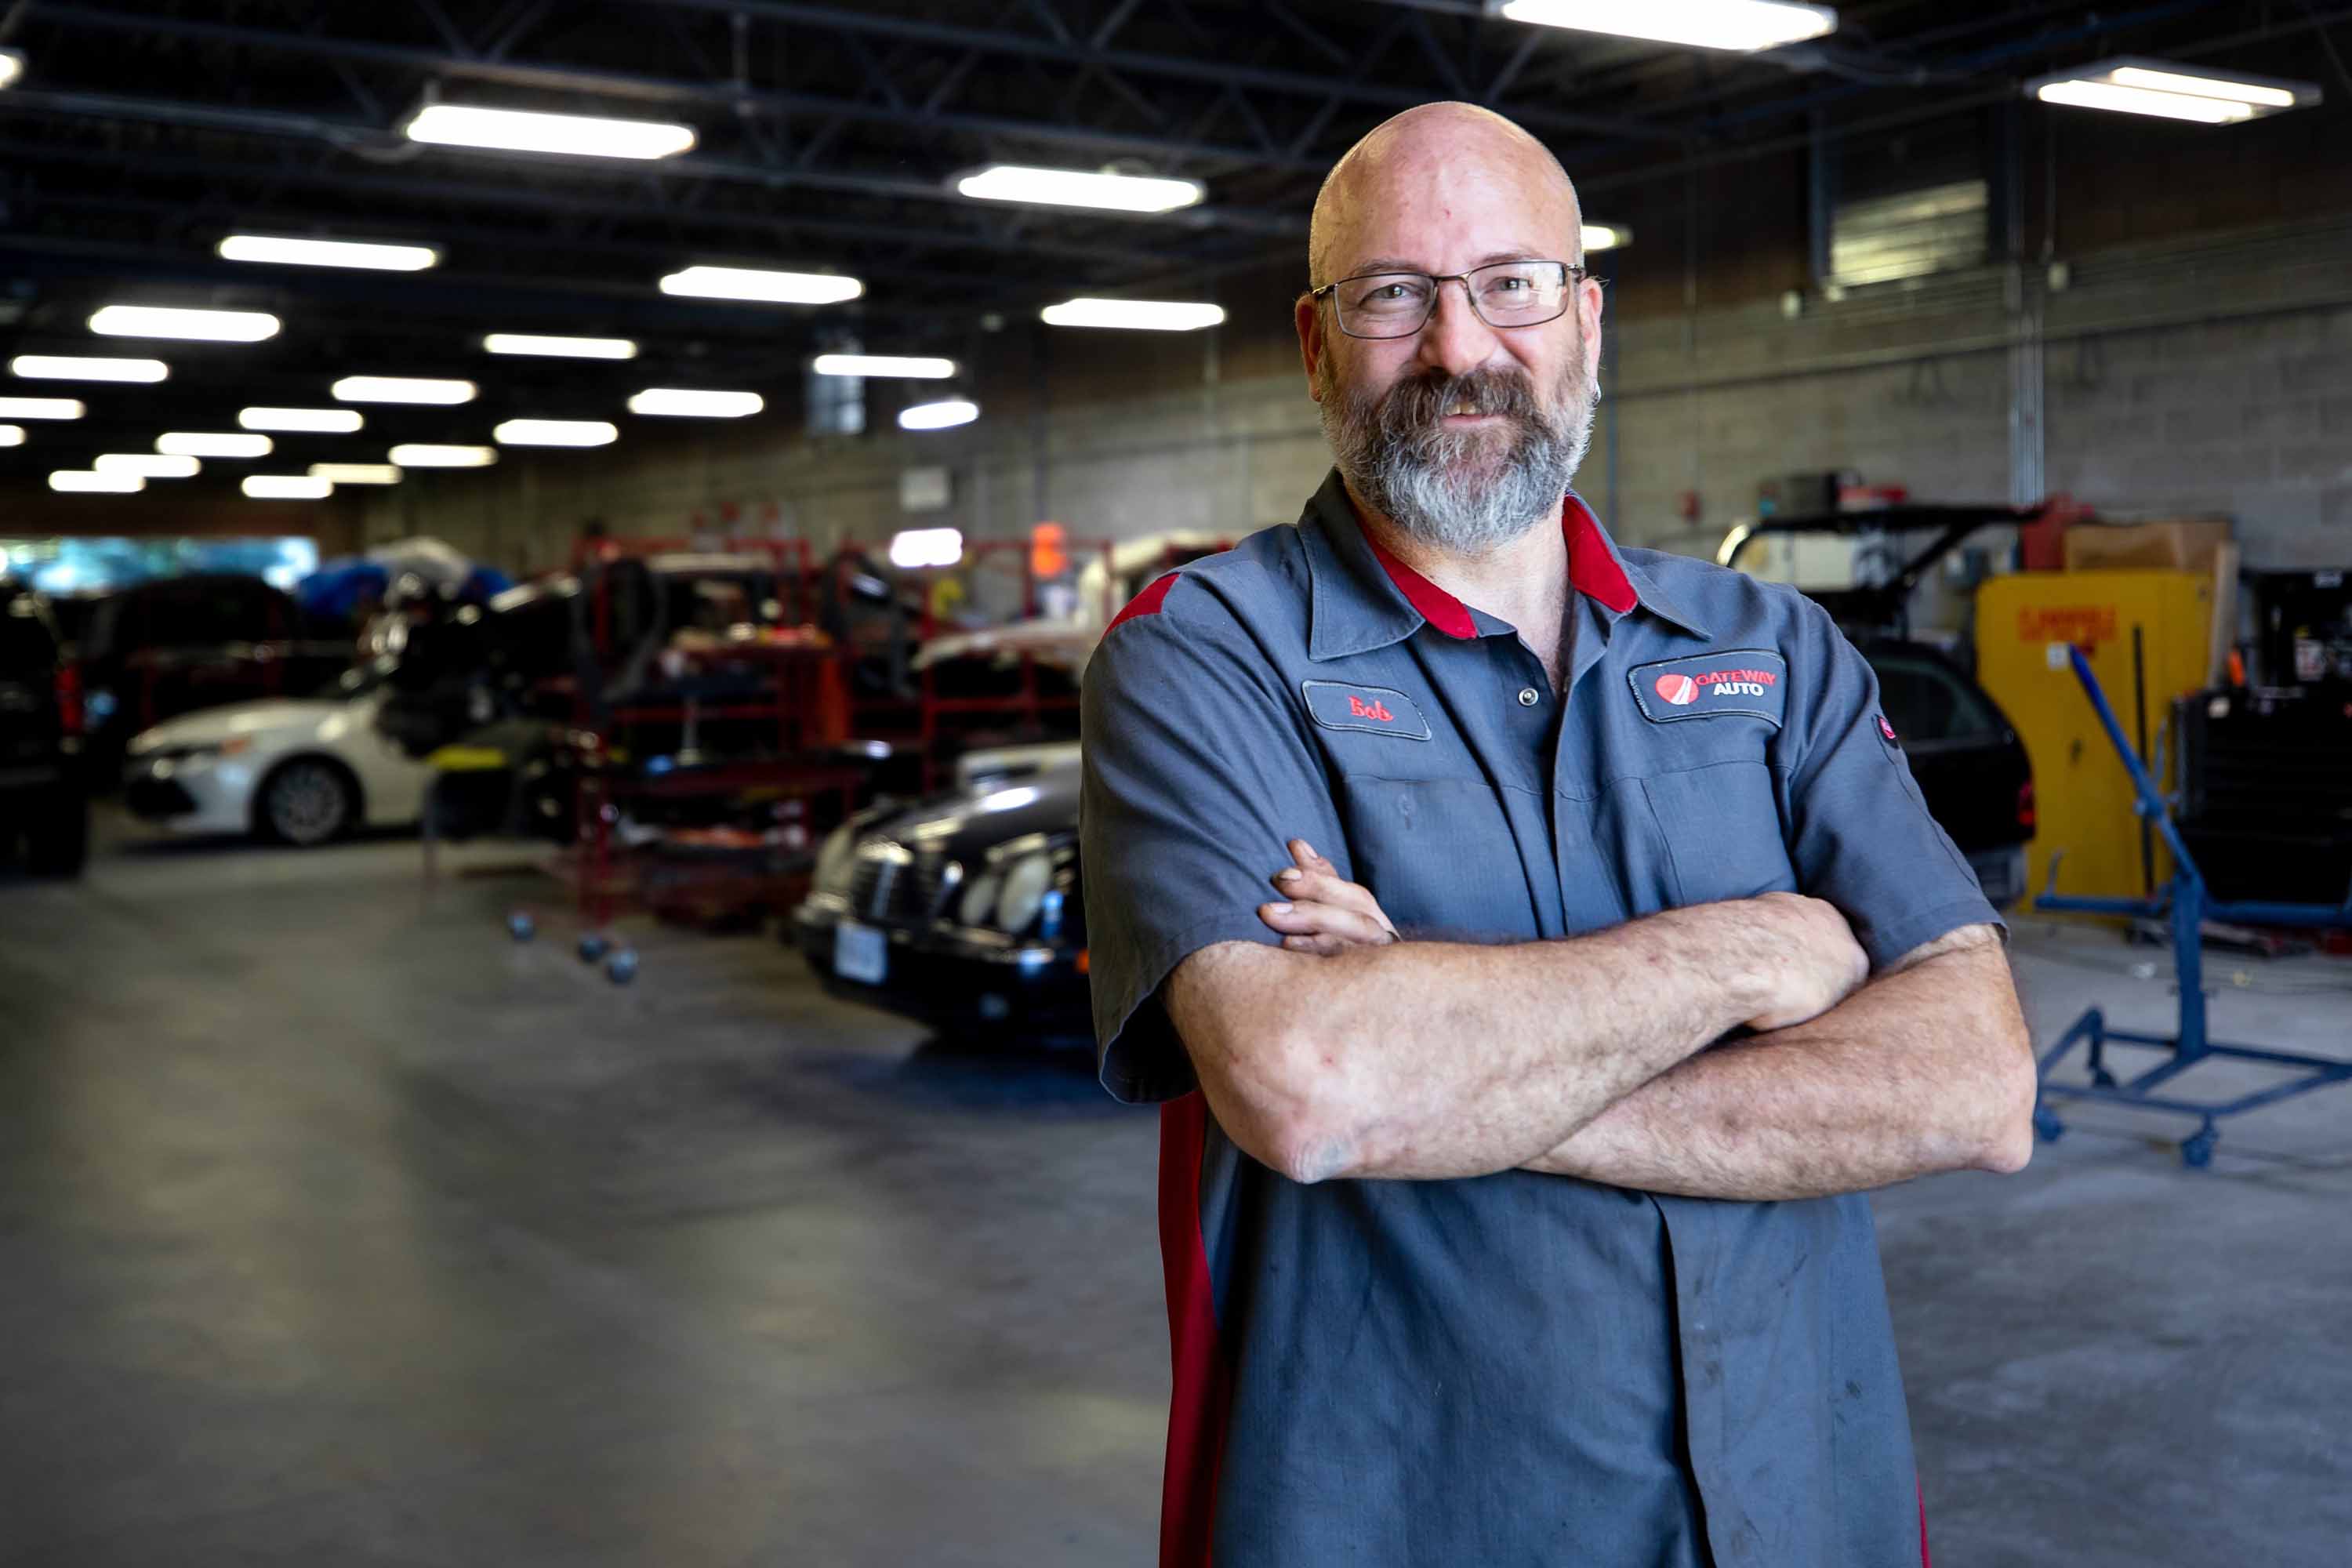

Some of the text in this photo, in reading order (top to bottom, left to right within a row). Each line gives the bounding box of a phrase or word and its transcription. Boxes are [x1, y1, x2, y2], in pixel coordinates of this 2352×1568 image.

[1695, 670, 1777, 685] GATEWAY
[1714, 683, 1764, 696] AUTO
[1348, 695, 1393, 721] Bob
